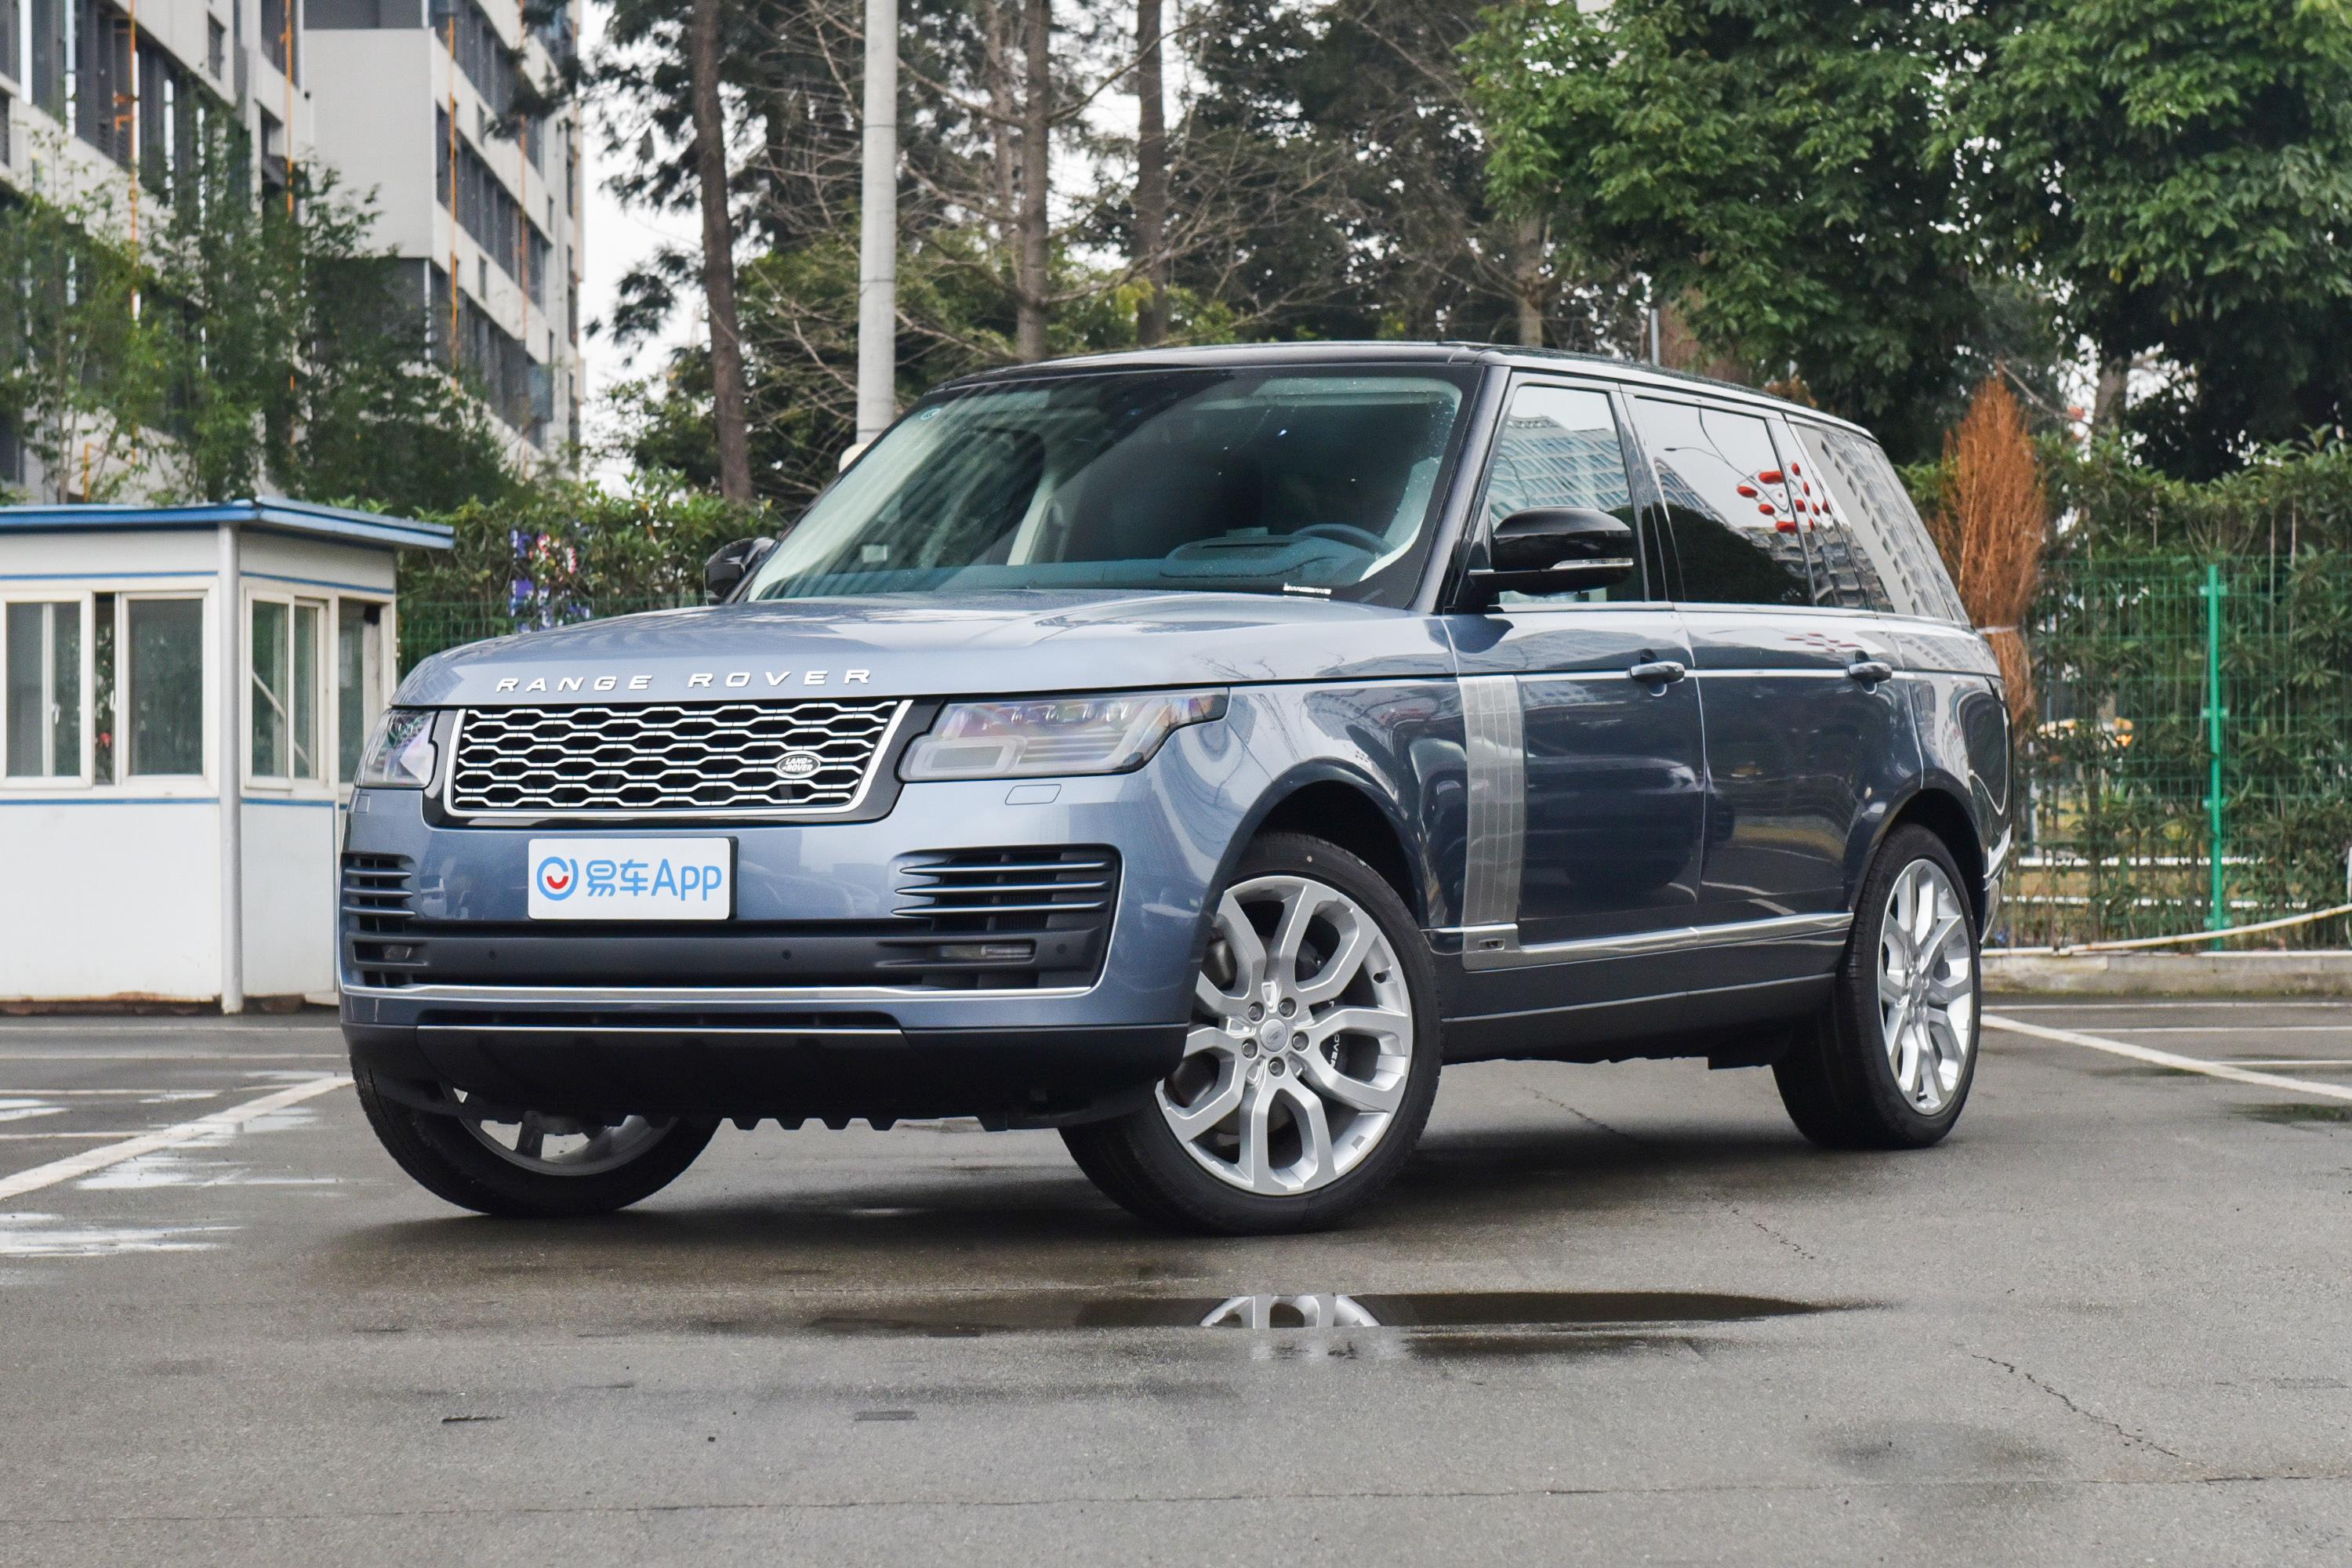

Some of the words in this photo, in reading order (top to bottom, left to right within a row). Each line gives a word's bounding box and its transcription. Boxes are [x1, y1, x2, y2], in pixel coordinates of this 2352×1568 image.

[495, 675, 652, 692] RANGE
[688, 669, 870, 688] ROVER
[586, 858, 723, 902] 易车App
